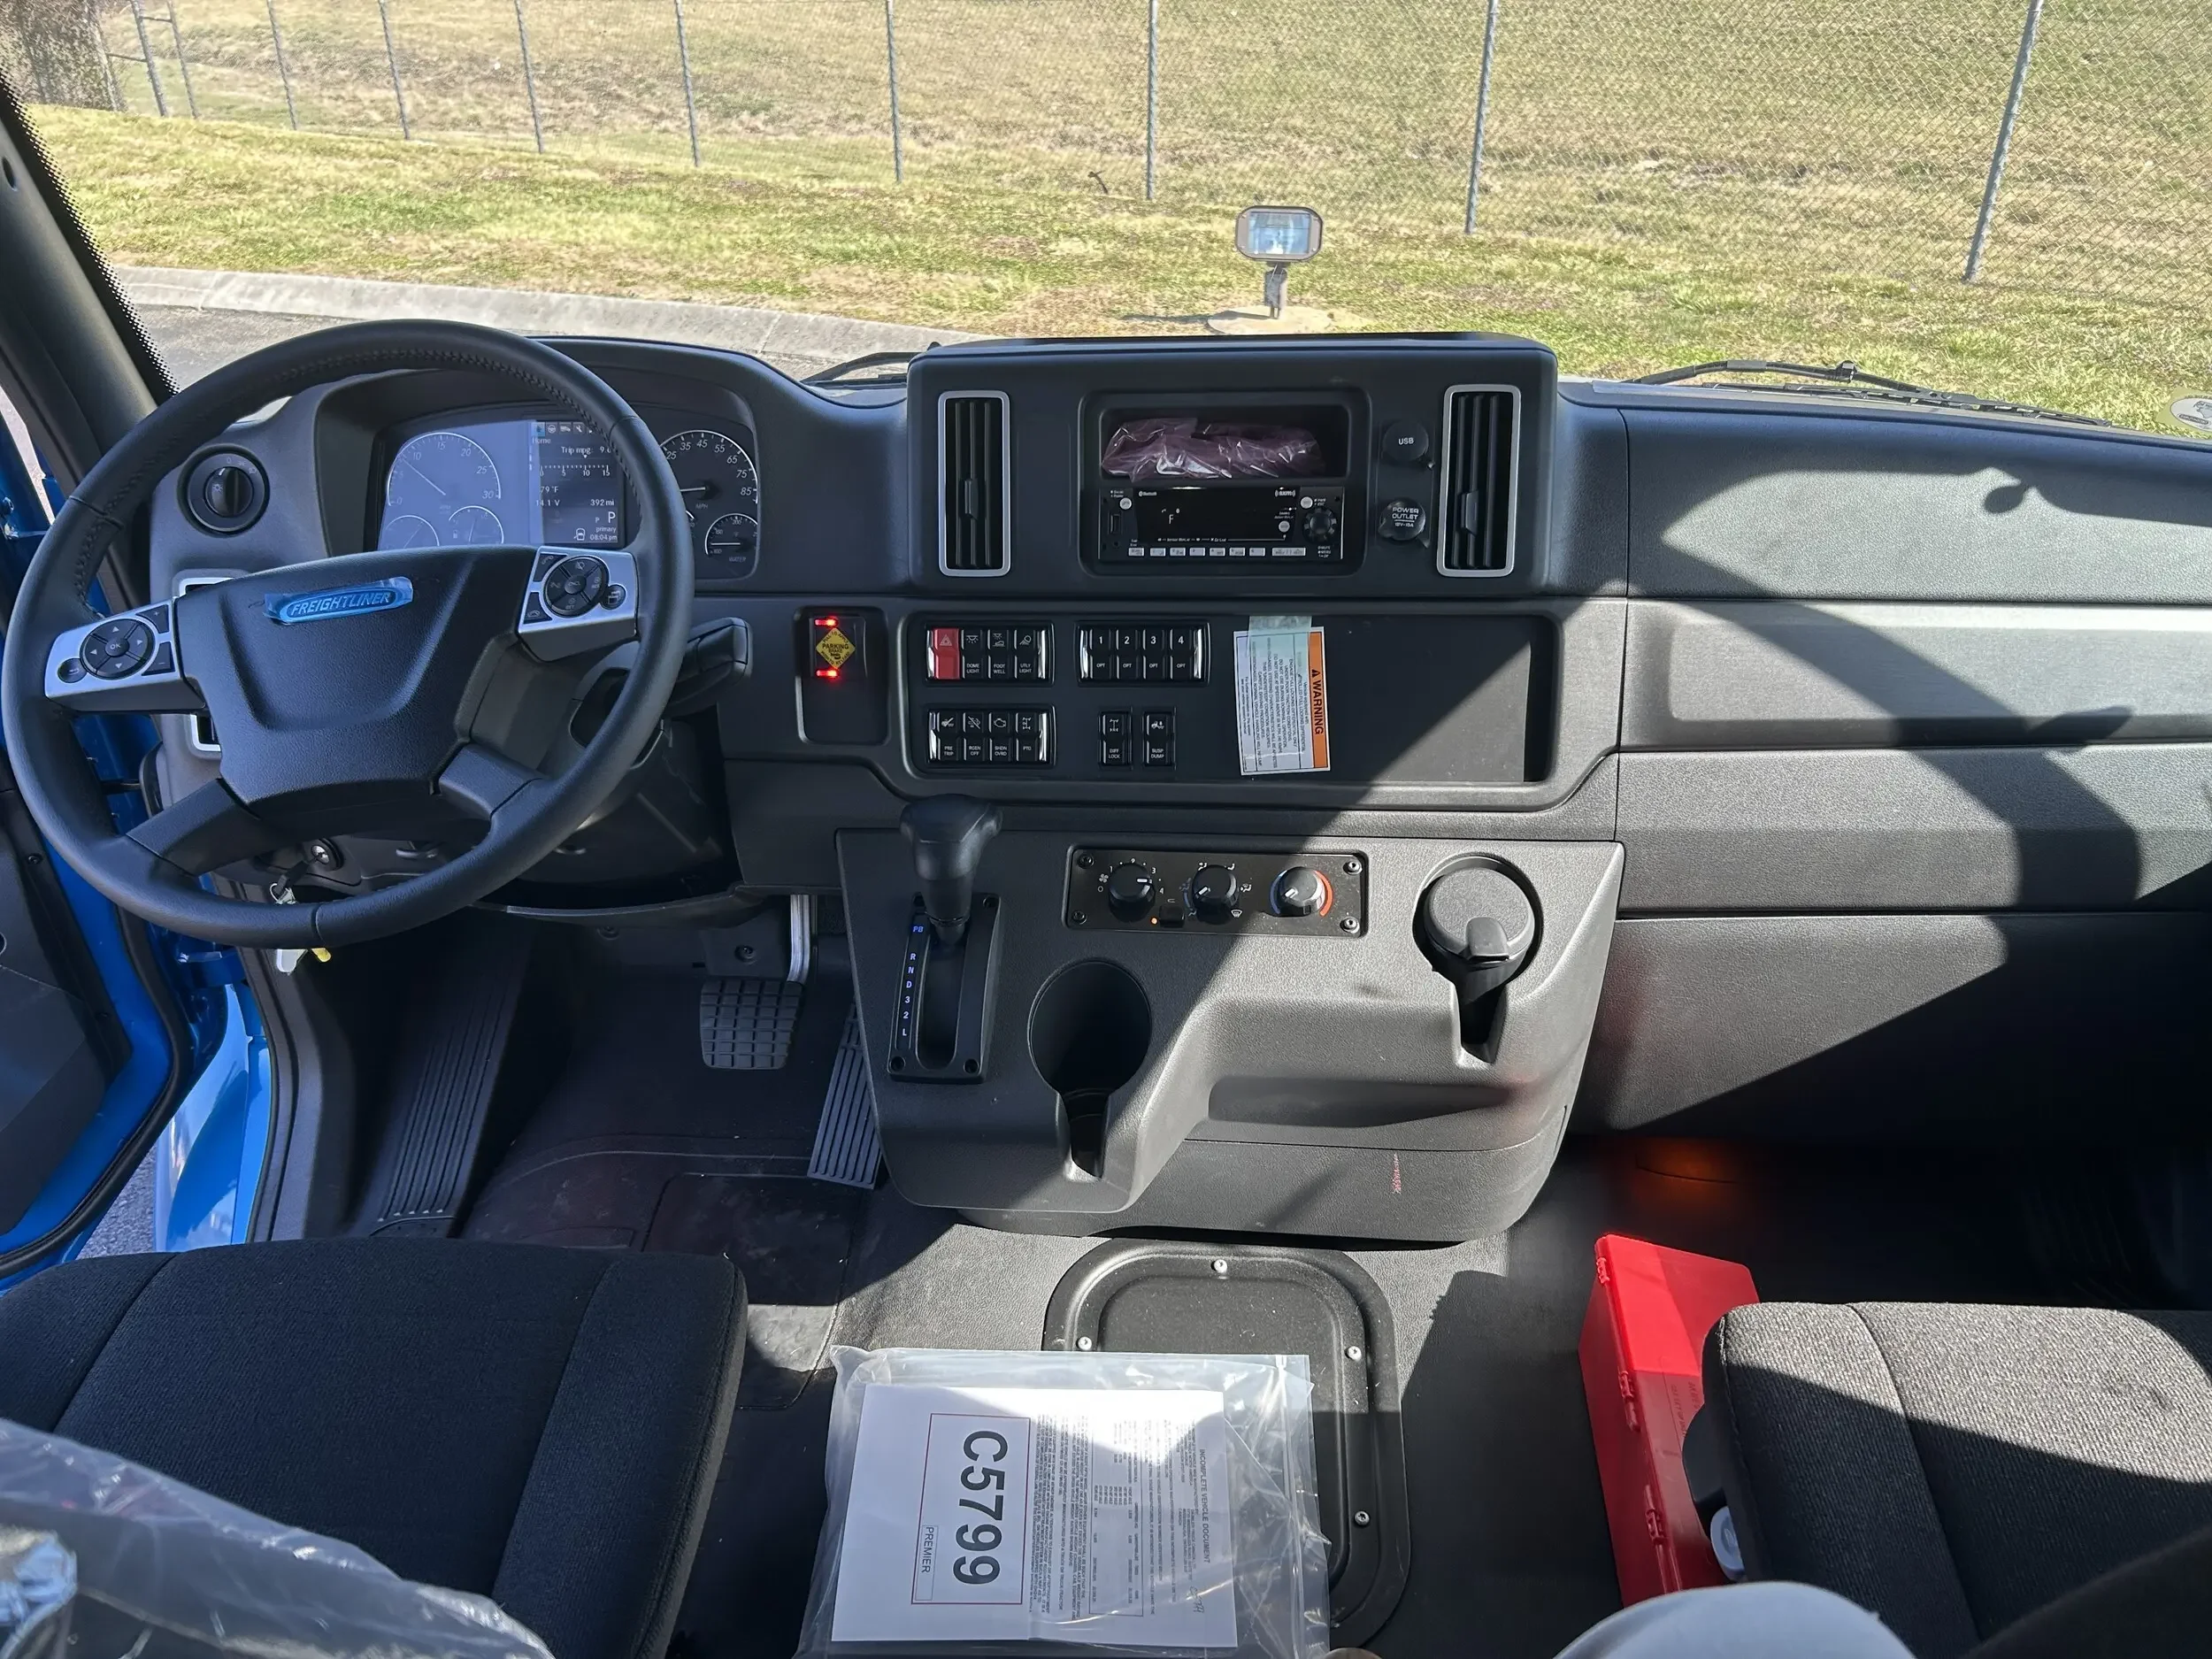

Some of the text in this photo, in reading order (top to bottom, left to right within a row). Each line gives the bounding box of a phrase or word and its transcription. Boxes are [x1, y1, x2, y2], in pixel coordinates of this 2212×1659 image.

[680, 442, 691, 451] 35
[696, 439, 708, 448] 45
[461, 448, 472, 457] 20
[561, 446, 574, 457] Trip
[714, 444, 726, 453] 55
[413, 452, 421, 461] 10
[666, 451, 677, 460] 25
[726, 455, 738, 465] 65
[736, 469, 748, 479] 75
[482, 490, 495, 499] 30
[741, 487, 752, 496] 85
[608, 511, 617, 523] P
[290, 592, 391, 616] FREIGHTLINER
[1312, 680, 1324, 734] WARNING
[953, 1430, 1009, 1585] C5799
[921, 1526, 934, 1573] PREMIER
